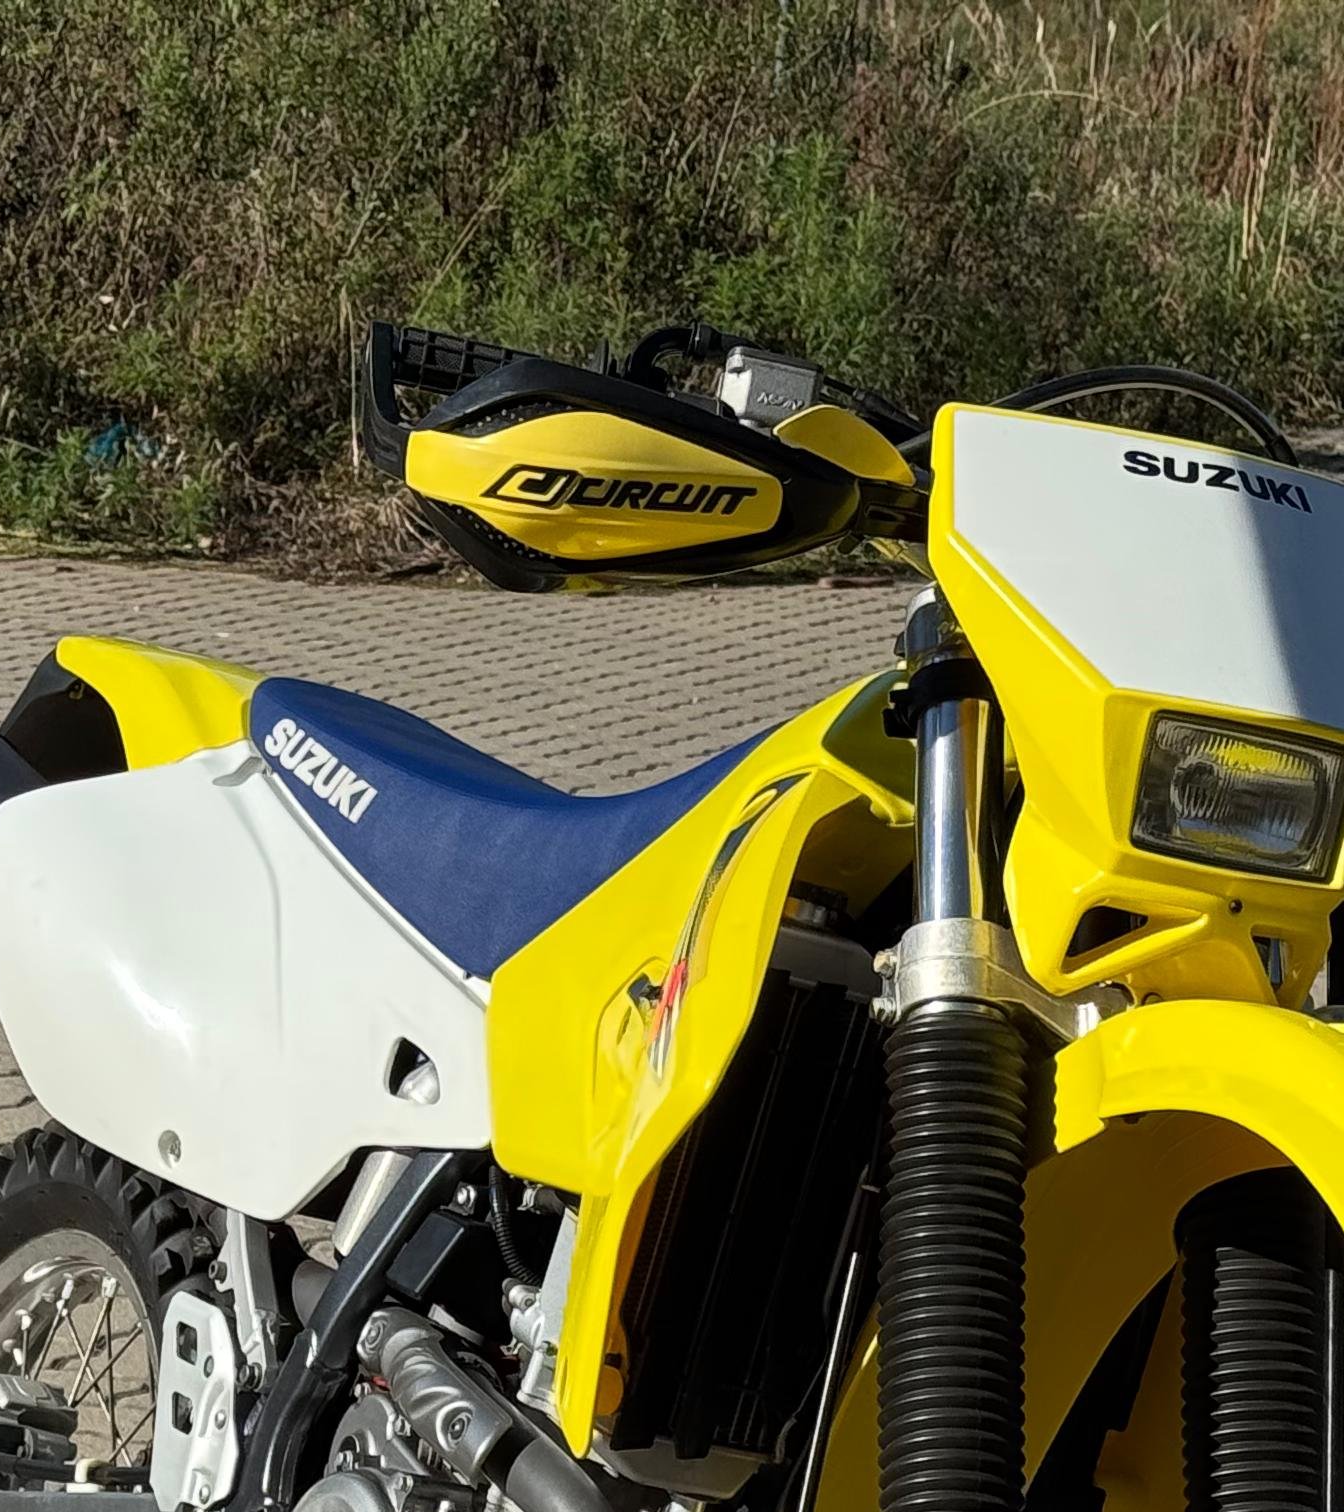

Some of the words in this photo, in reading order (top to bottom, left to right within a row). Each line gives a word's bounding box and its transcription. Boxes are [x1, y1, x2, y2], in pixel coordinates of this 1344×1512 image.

[566, 476, 758, 516] CIRCUIT
[1122, 449, 1314, 514] SUZUKI
[264, 718, 378, 824] SUZUKI
